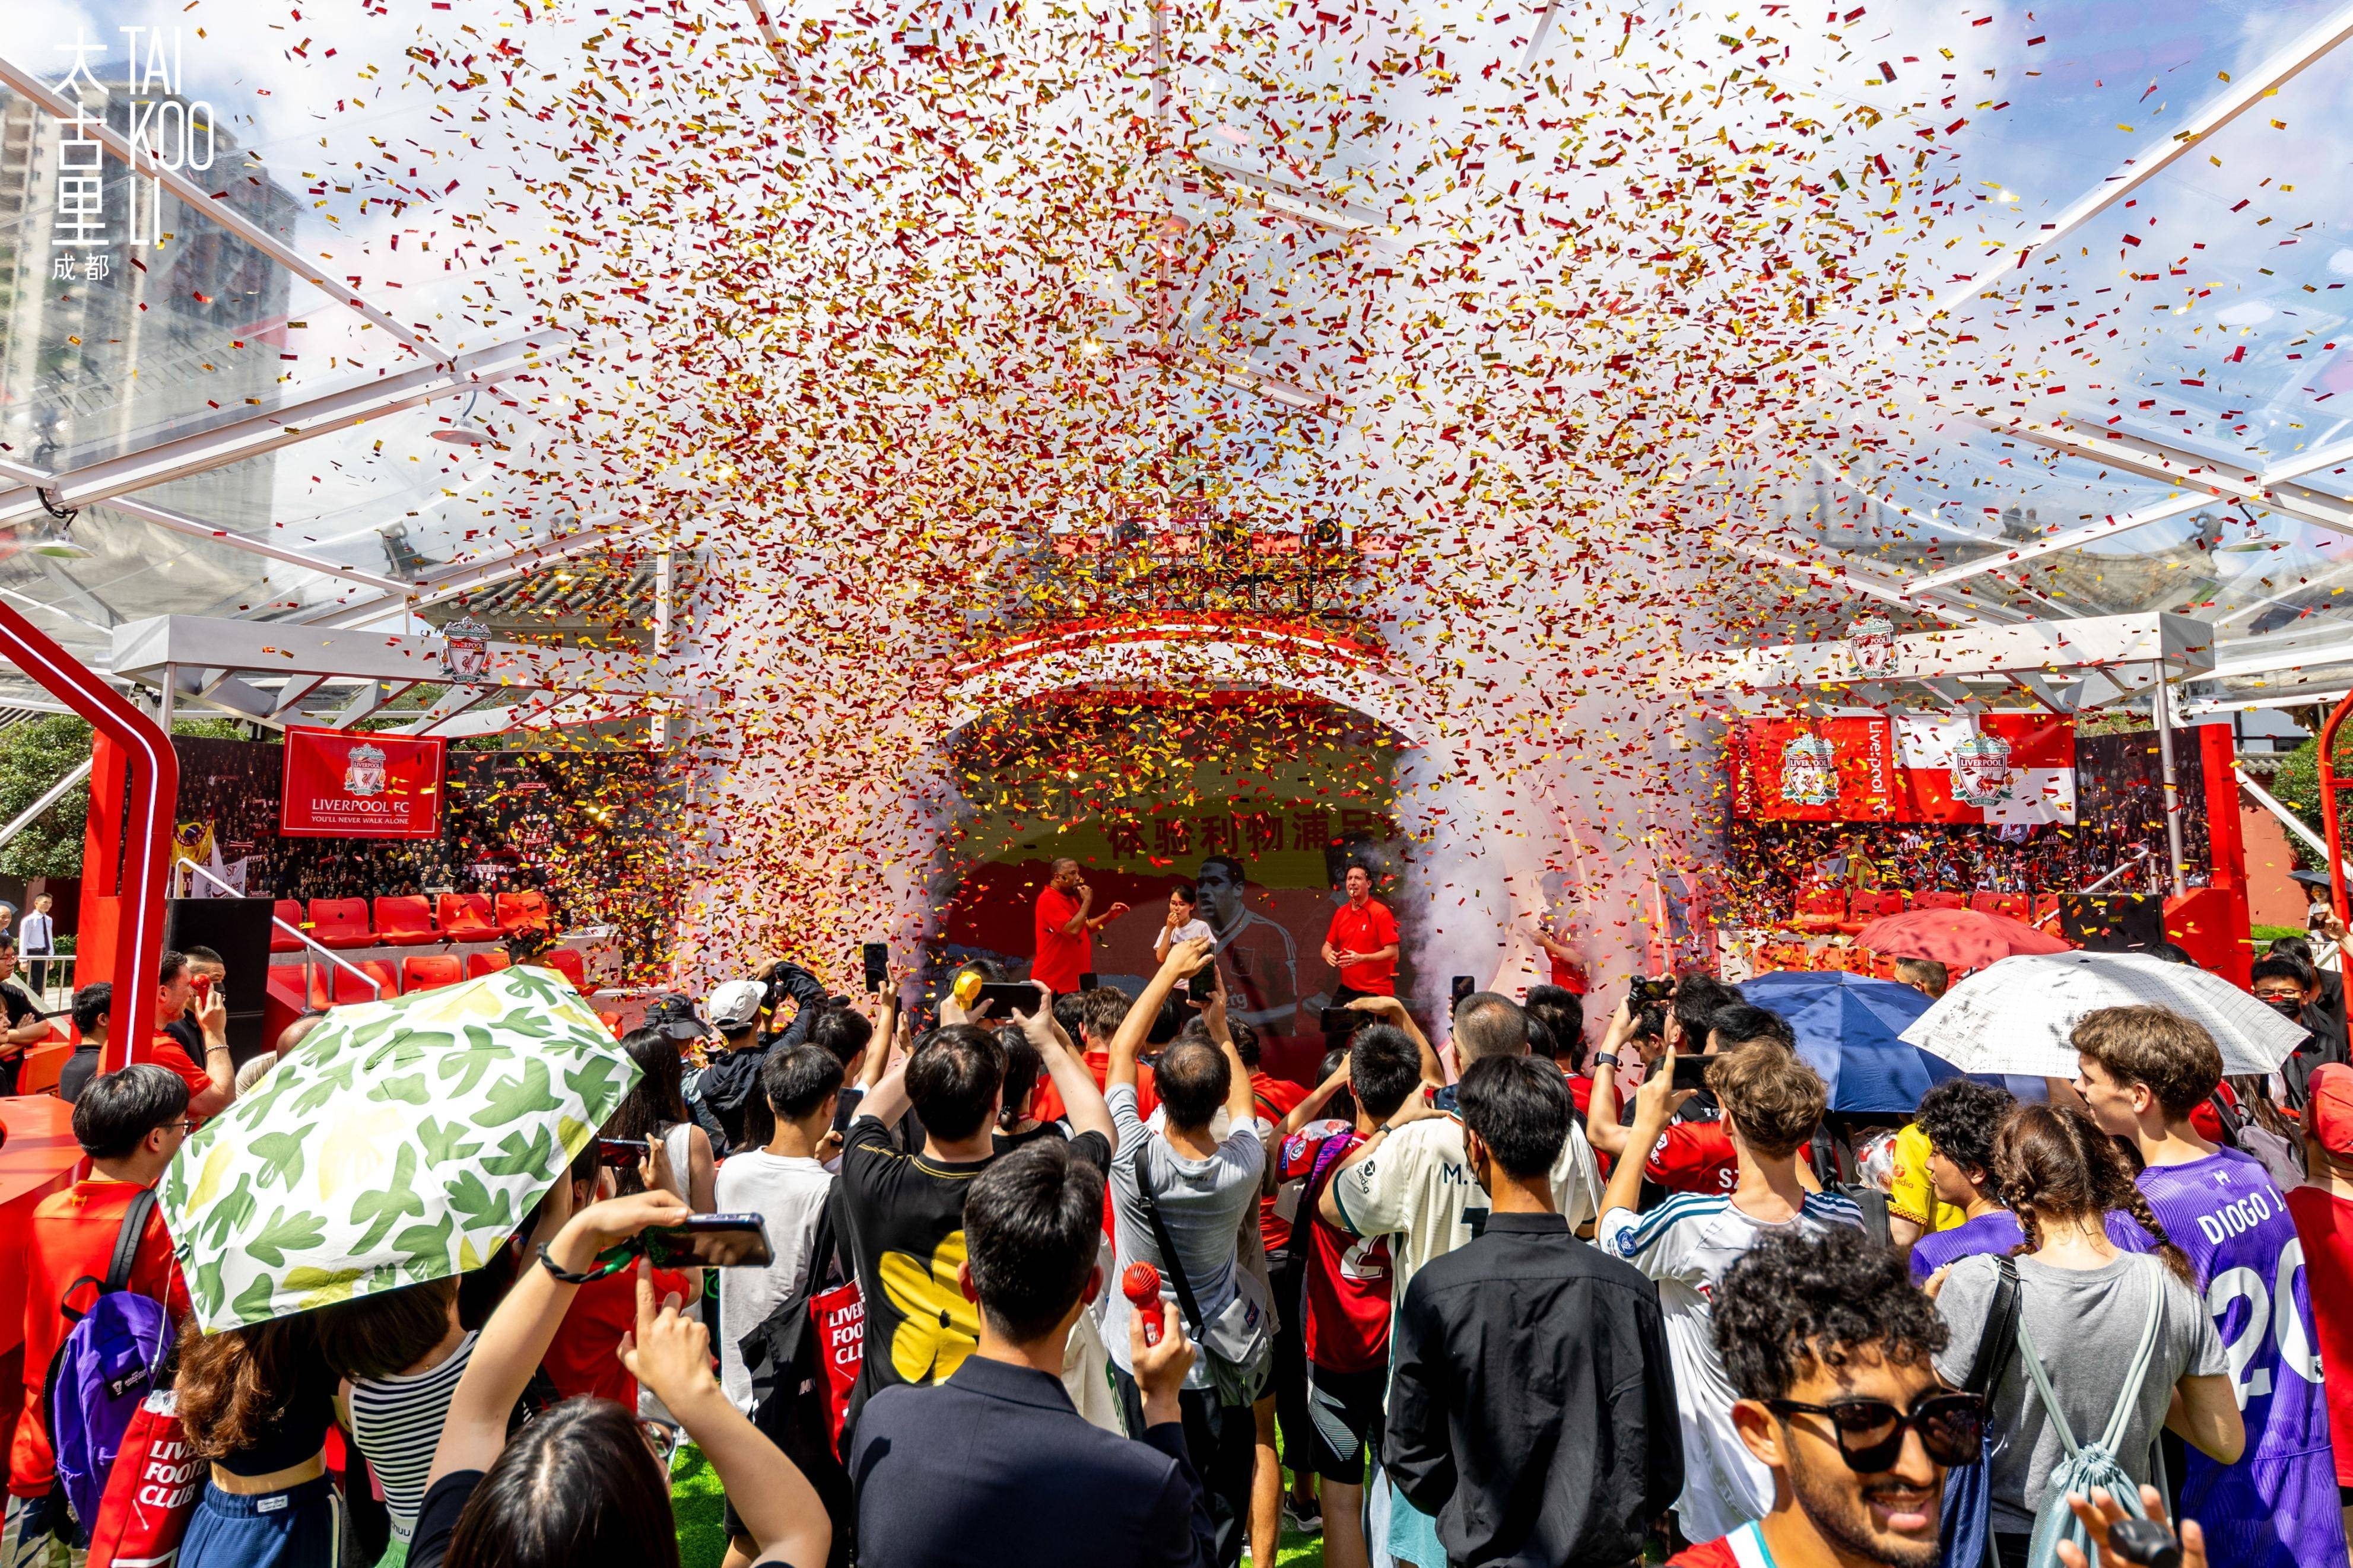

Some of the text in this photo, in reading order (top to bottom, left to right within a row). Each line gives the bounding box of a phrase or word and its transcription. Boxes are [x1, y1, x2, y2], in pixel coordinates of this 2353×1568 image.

[312, 799, 410, 813] LIVERPOOL FC
[2197, 1192, 2271, 1246] DIOGO
[829, 1303, 865, 1328] LIVER
[2205, 1237, 2326, 1412] 20
[832, 1321, 864, 1347] FOO
[149, 1440, 198, 1460] LIVE
[143, 1459, 209, 1484] FOOTB
[139, 1483, 196, 1509] CLUB
